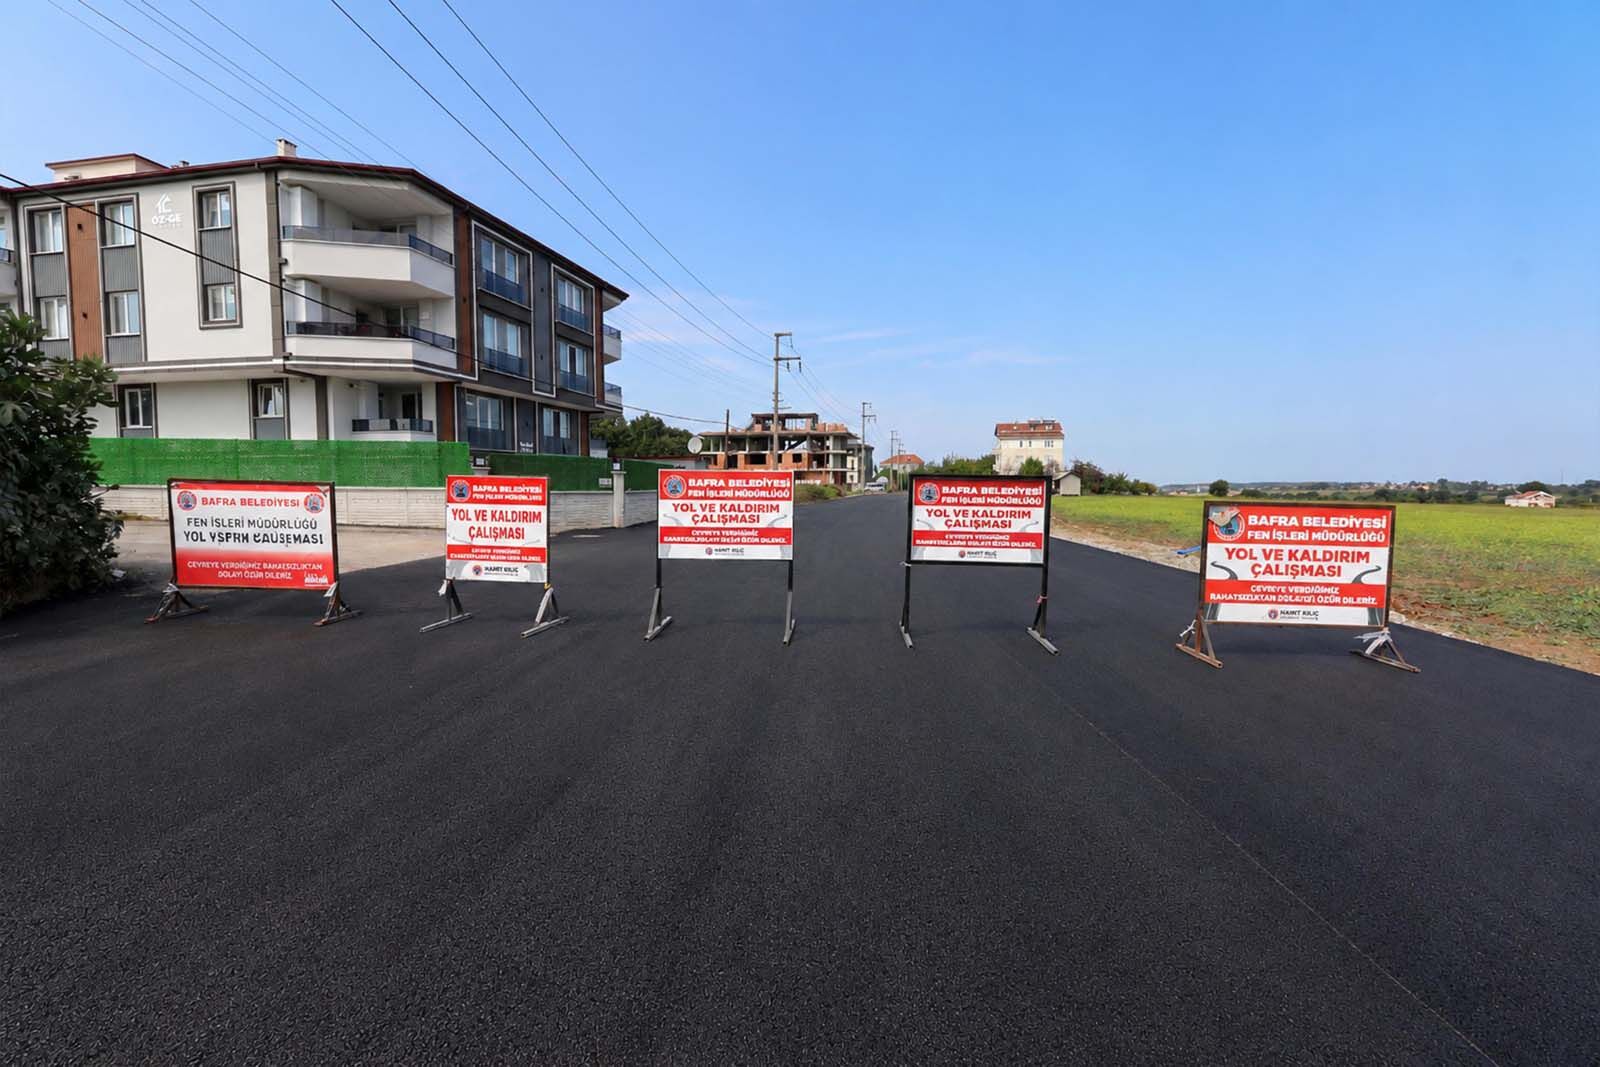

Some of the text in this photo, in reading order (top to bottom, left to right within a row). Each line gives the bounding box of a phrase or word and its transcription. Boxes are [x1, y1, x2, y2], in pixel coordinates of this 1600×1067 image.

[688, 478, 790, 488] BAFRA BELEDİYESİ
[942, 486, 1042, 496] BAFRA BELEDİYESİ
[201, 497, 236, 506] BAFRA
[672, 503, 780, 513] YOL VE KALDIRIM
[926, 508, 1031, 519] YOL VE KALDIRIM
[451, 508, 542, 523] YOL VE KALDIRIM
[692, 514, 760, 525] ÇALIŞMASI
[187, 518, 208, 528] FEN
[944, 519, 1012, 530] ÇALIŞMASI
[1248, 515, 1387, 529] BAFRA BELEDİYESİ
[184, 531, 206, 543] YOL
[468, 526, 525, 542] ÇALIŞMASI
[1247, 529, 1385, 543] FEN İŞLERİ MÜDÜRLÜĞÜ
[1224, 548, 1370, 563] YOL VE KALDIRIM
[1251, 563, 1342, 579] ÇALIŞMASI
